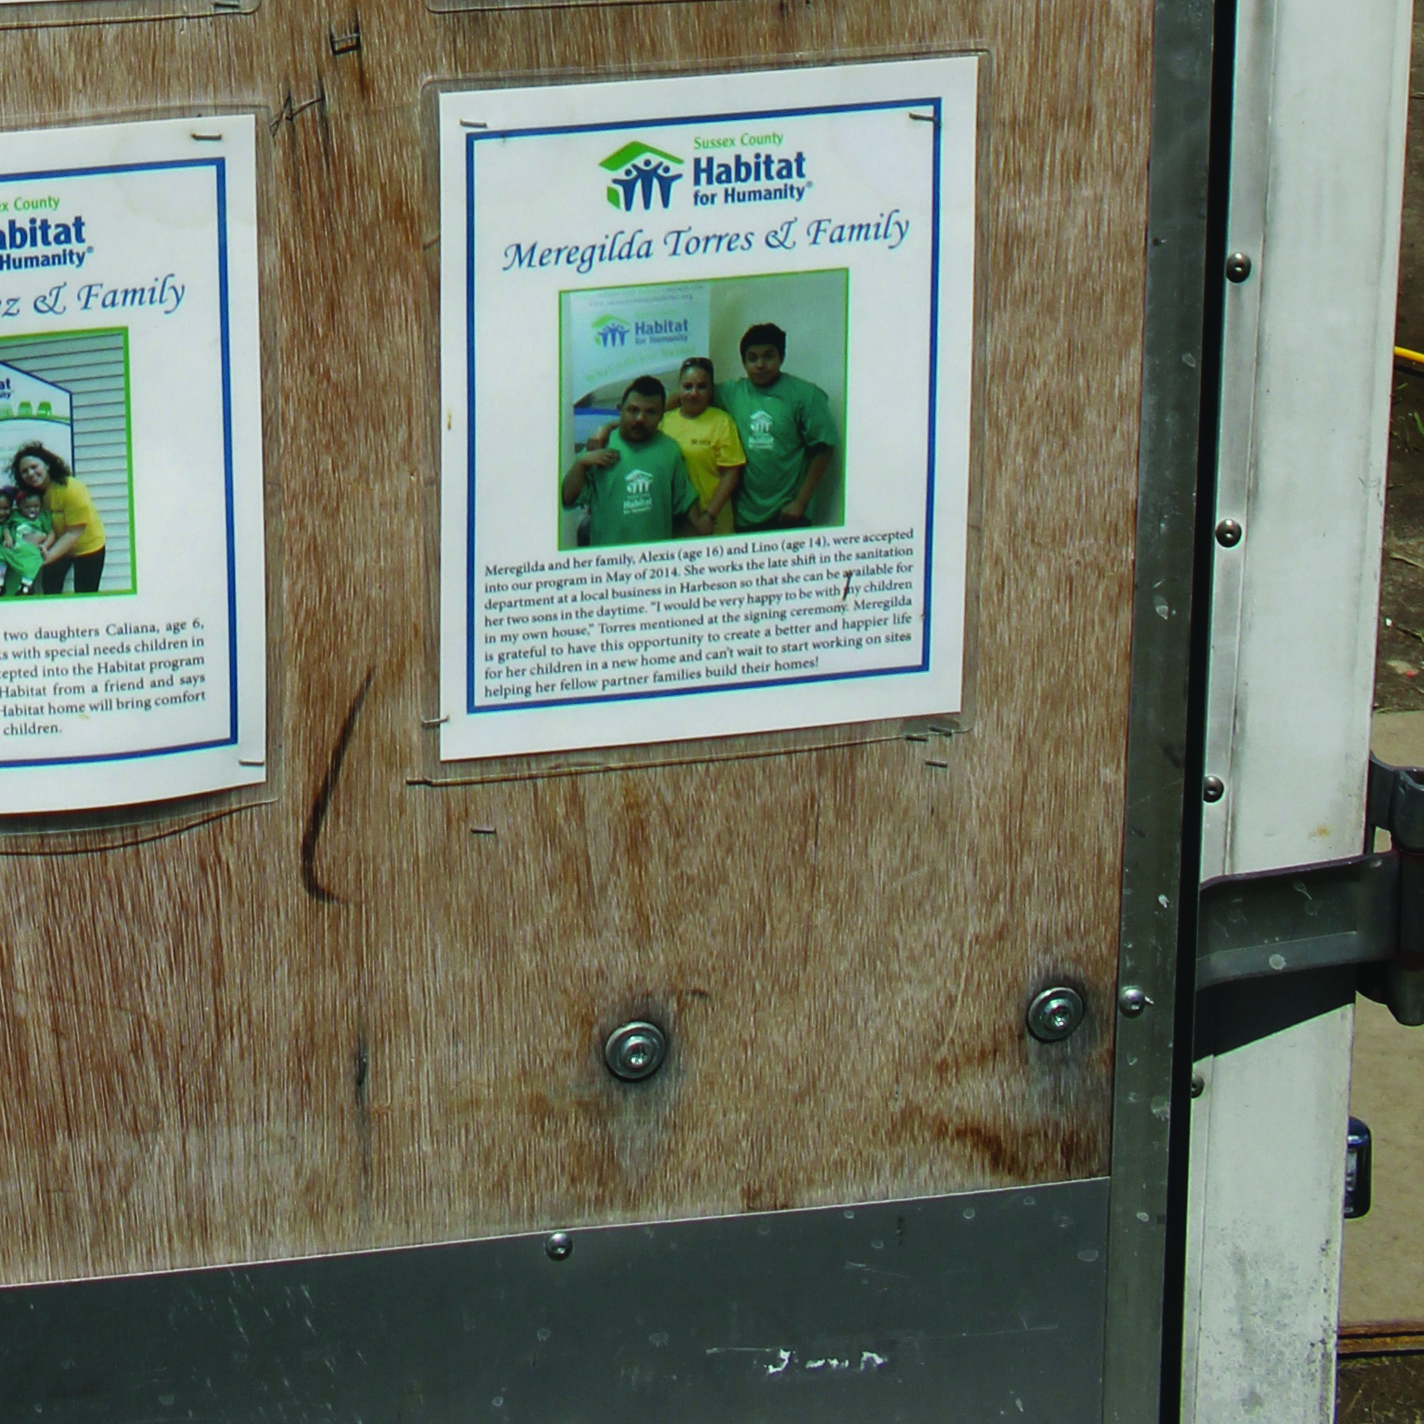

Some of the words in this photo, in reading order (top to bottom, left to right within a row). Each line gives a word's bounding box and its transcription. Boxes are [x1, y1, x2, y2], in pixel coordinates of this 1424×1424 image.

[695, 139, 735, 149] Sussex
[741, 134, 782, 145] County
[694, 152, 806, 189] Habitat
[14, 196, 59, 211] County
[694, 190, 717, 206] for
[503, 229, 653, 274] Meregilda
[664, 226, 754, 256] Torres
[807, 209, 909, 249] Family
[77, 274, 185, 314] Family
[635, 318, 688, 336] Habitat
[485, 686, 531, 699] helping
[536, 682, 554, 693] her
[561, 679, 596, 690] fellow
[602, 676, 648, 691] partner
[654, 670, 701, 682] families
[706, 664, 737, 677] build
[742, 663, 769, 674] their
[775, 657, 818, 671] homes!
[3, 723, 61, 736] children.
